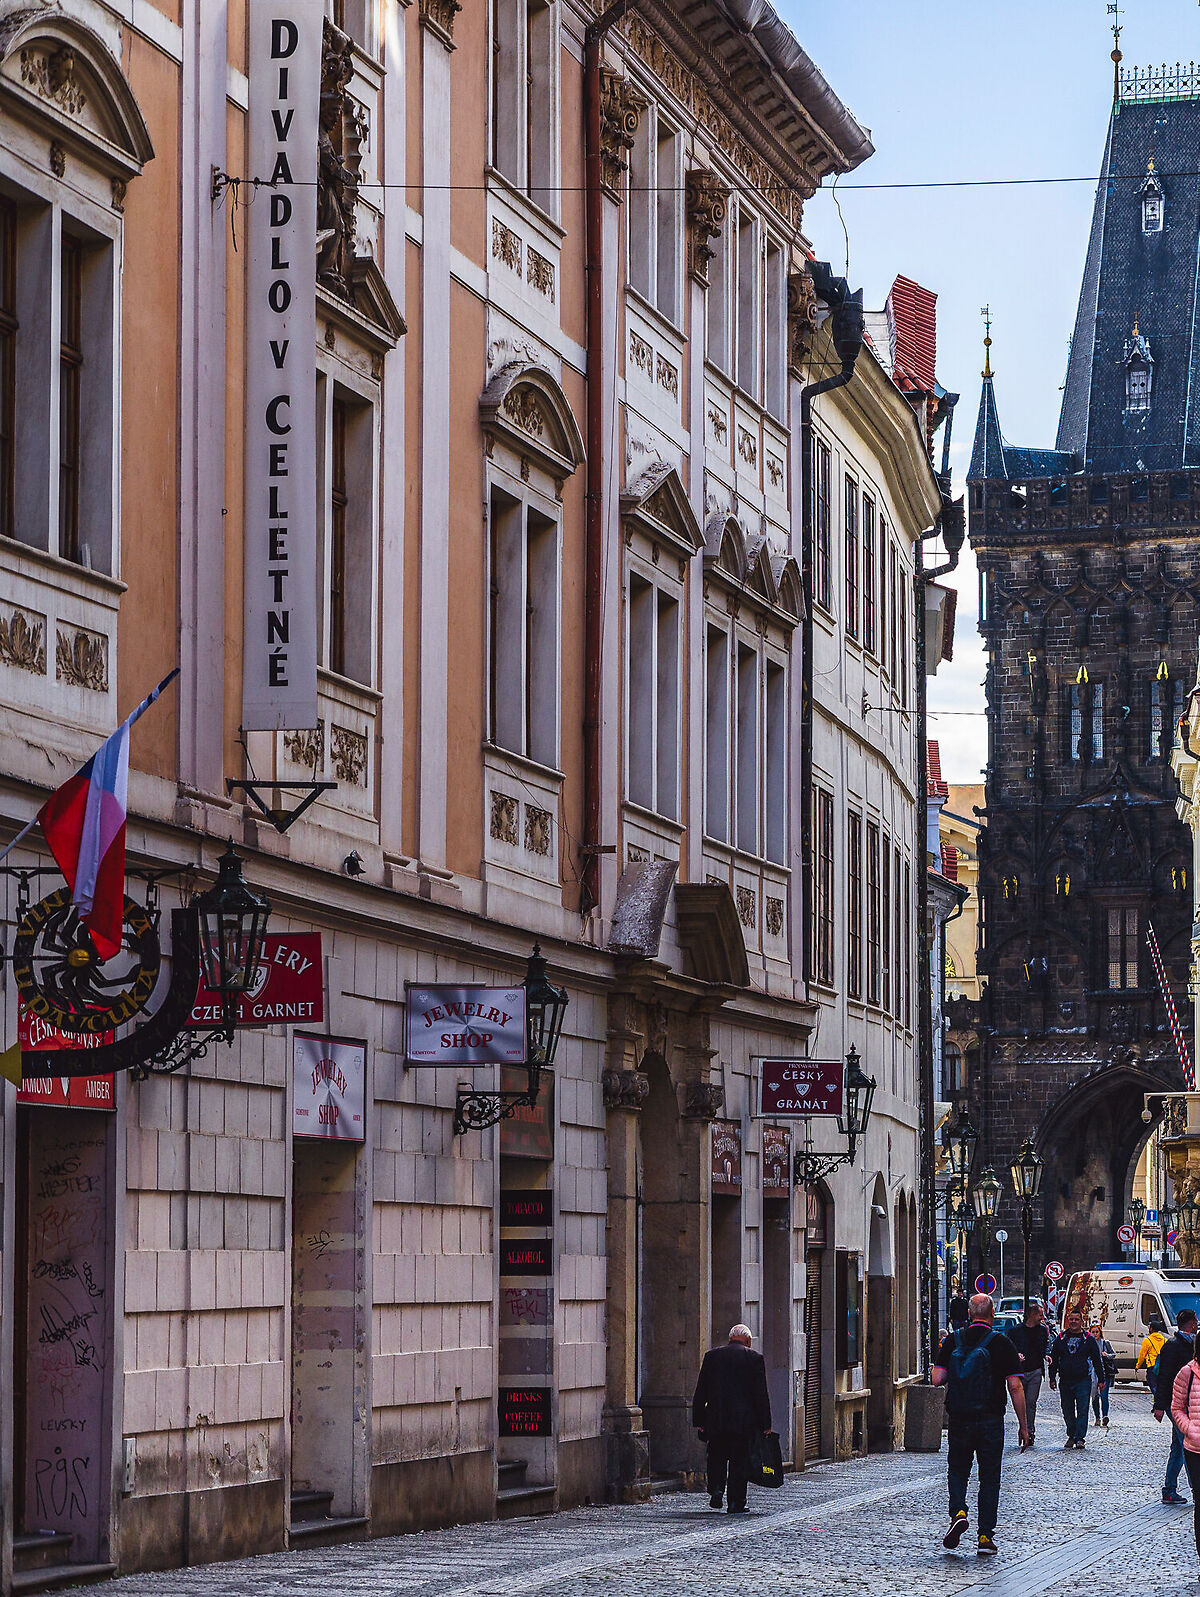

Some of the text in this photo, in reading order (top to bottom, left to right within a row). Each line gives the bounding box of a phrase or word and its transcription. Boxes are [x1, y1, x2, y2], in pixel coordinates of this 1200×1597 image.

[265, 19, 299, 687] DIVADLO V CELETNÉ
[191, 1002, 315, 1020] CZEH GARNET
[422, 1001, 512, 1028] JEWELRY
[440, 1033, 493, 1048] SHOP
[311, 1058, 347, 1098] JEWELRY
[782, 1069, 824, 1081] ČESKÝ
[17, 1077, 110, 1099] IAMOND AMBER
[776, 1098, 828, 1110] GRANÁT
[318, 1104, 339, 1125] SHOP
[507, 1202, 543, 1214] TOBACCO
[506, 1251, 544, 1264] ALKOHOL
[506, 1392, 543, 1402] DRINKS
[505, 1412, 543, 1422] COFFEE
[510, 1422, 539, 1432] TO GO
